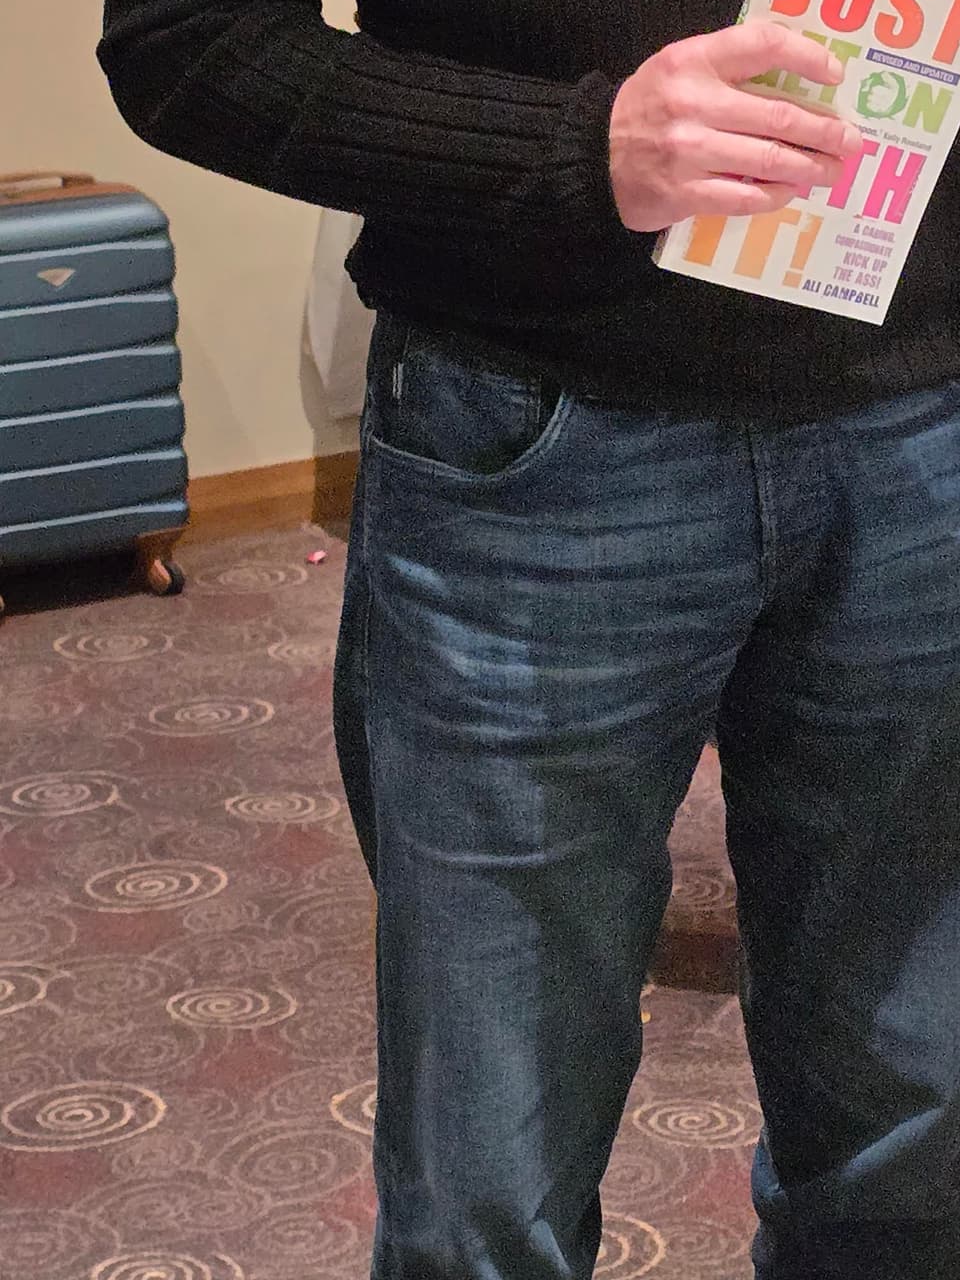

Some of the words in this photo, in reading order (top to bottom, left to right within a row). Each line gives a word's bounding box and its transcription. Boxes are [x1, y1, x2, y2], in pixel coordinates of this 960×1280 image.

[872, 51, 902, 69] REVISED
[903, 60, 919, 73] AND
[920, 63, 955, 83] UPDATED
[856, 70, 954, 134] ON
[843, 251, 871, 271] KICK
[872, 258, 888, 273] UP
[833, 266, 853, 282] THE
[855, 271, 882, 290] ASS!
[802, 279, 821, 294] ALI
[823, 283, 880, 308] CAMPBELL
